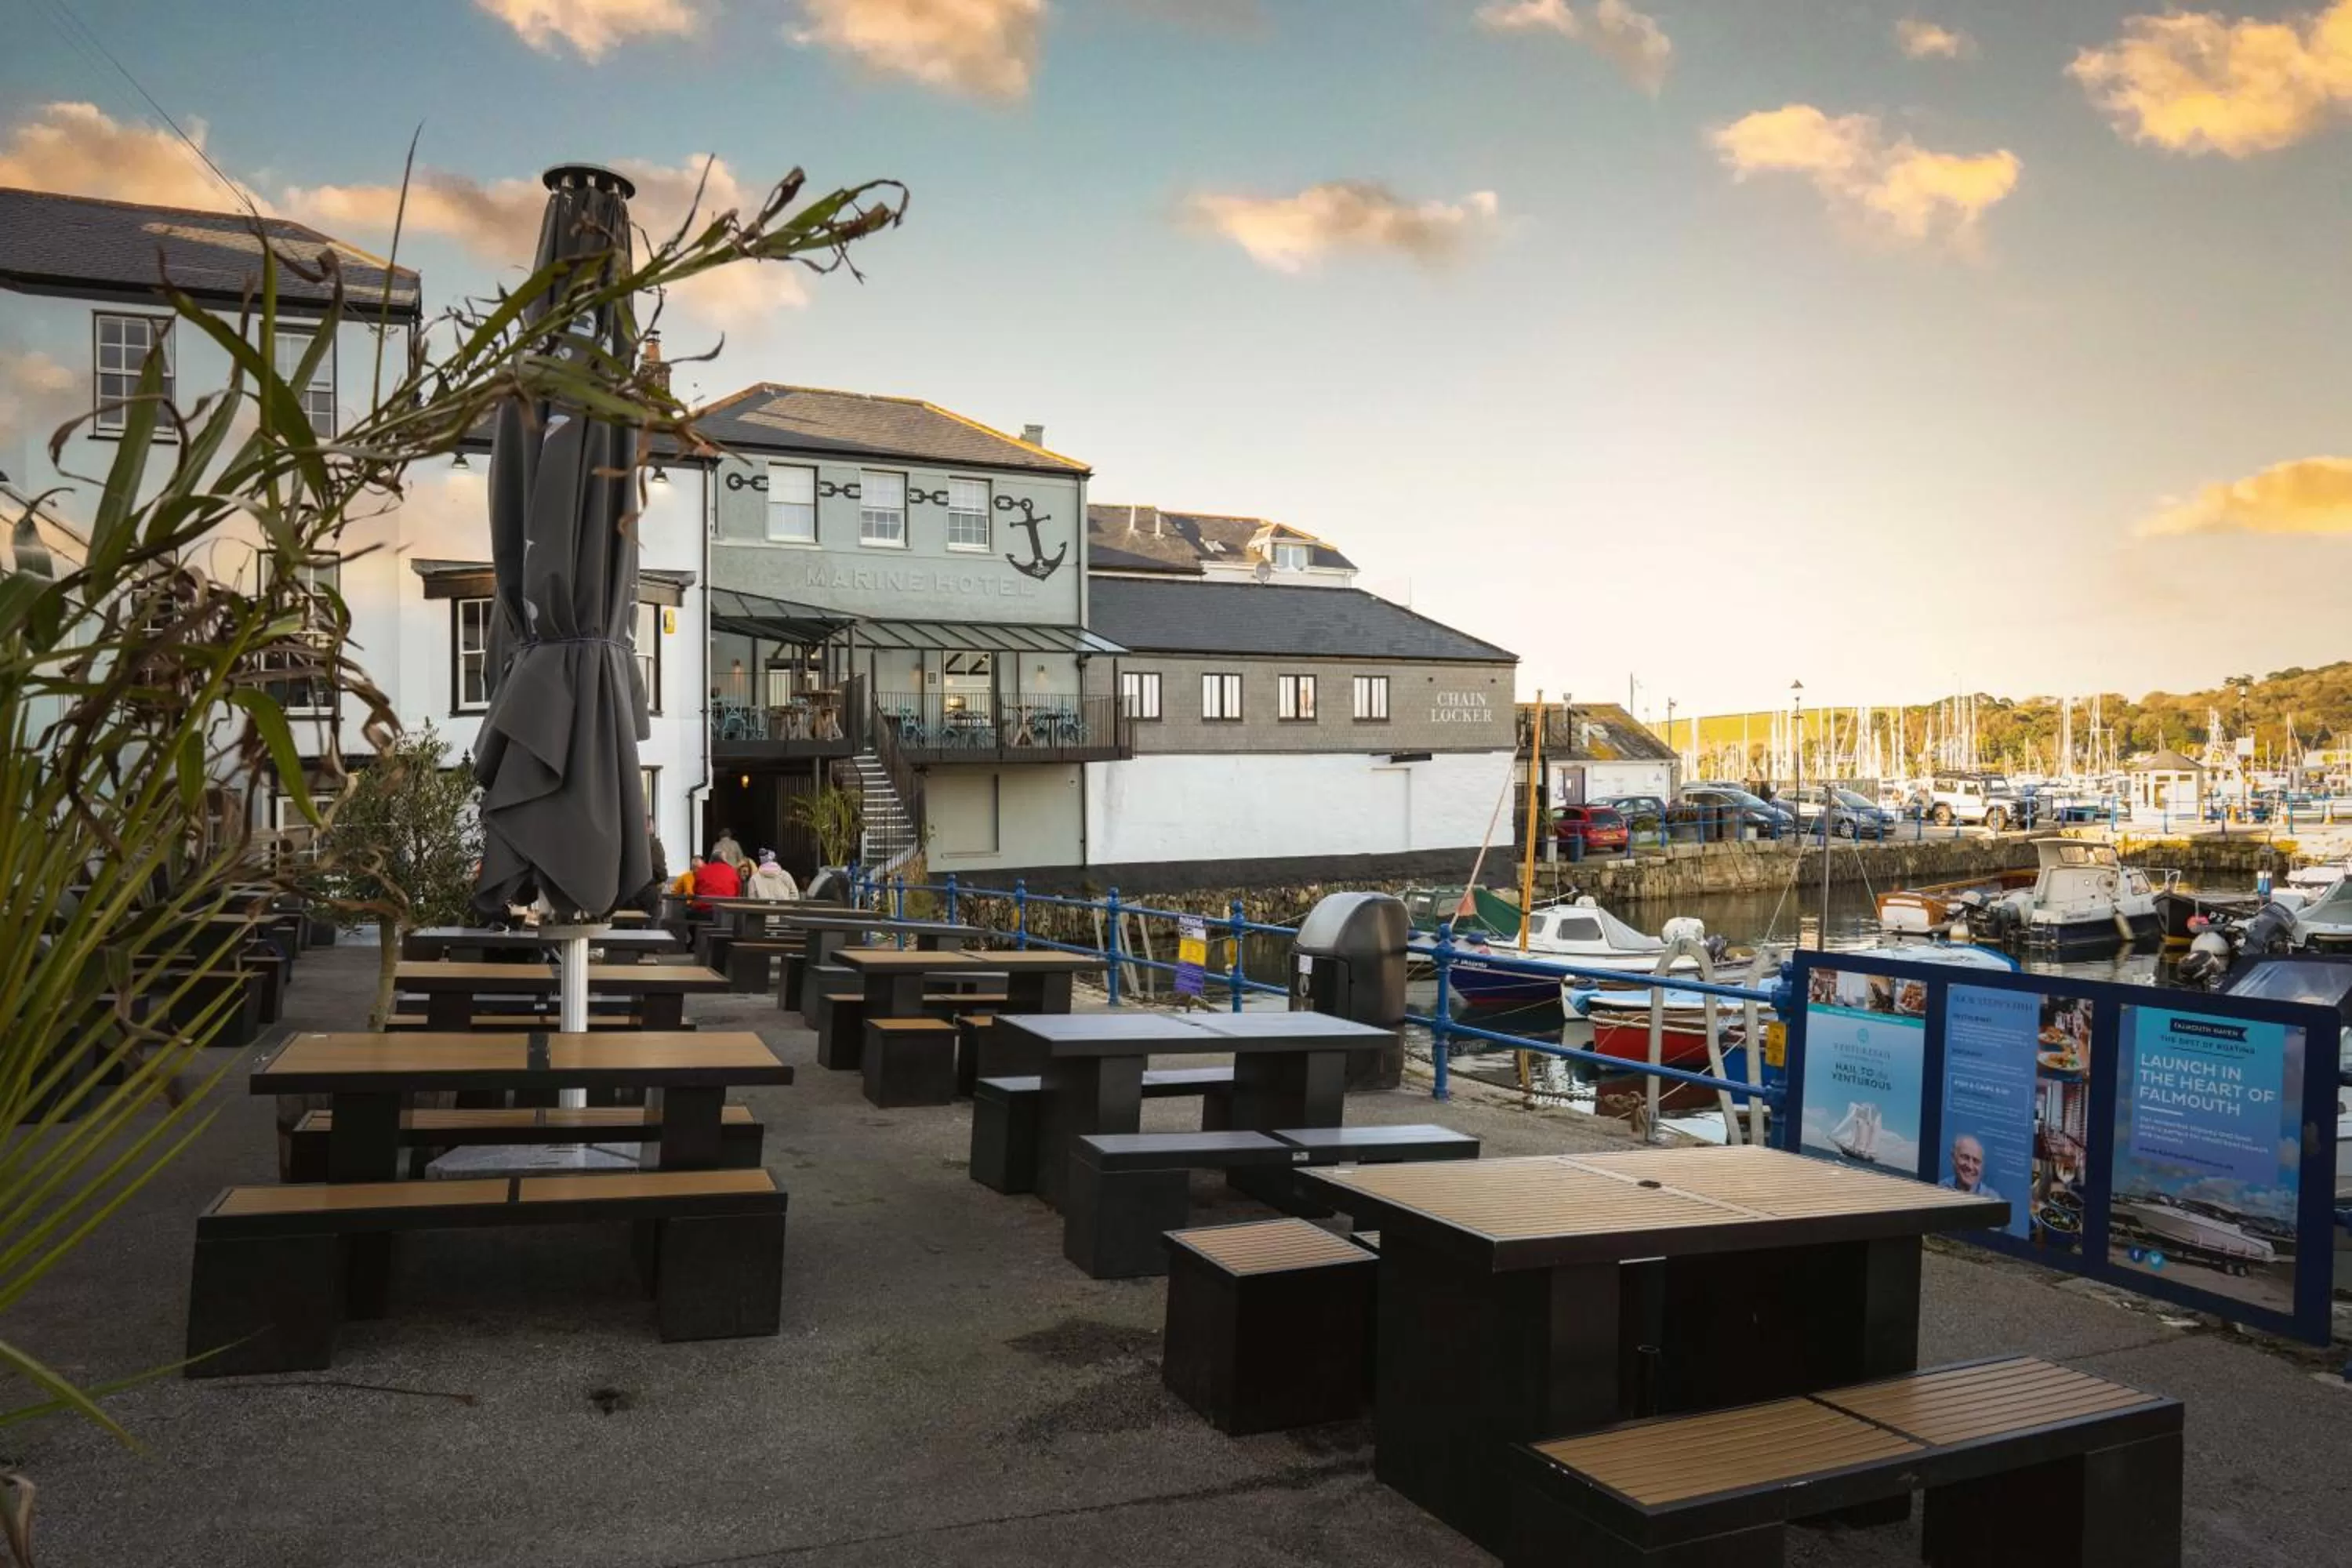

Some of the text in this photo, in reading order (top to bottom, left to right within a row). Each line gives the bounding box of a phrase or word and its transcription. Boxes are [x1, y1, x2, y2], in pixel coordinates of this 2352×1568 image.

[805, 564, 1036, 597] MARINE HOTEL
[1437, 691, 1486, 706] CHAIN
[1431, 708, 1493, 722] LOCKER
[2161, 1034, 2176, 1044] THE
[1835, 1062, 1856, 1073] HAIL
[1861, 1066, 1874, 1077] TO
[2141, 1053, 2241, 1082] LAUNCH IN
[1831, 1071, 1892, 1091] VENTUROUS
[2140, 1069, 2276, 1103] THE HEART OF
[2140, 1085, 2241, 1117] FALMOUTH
